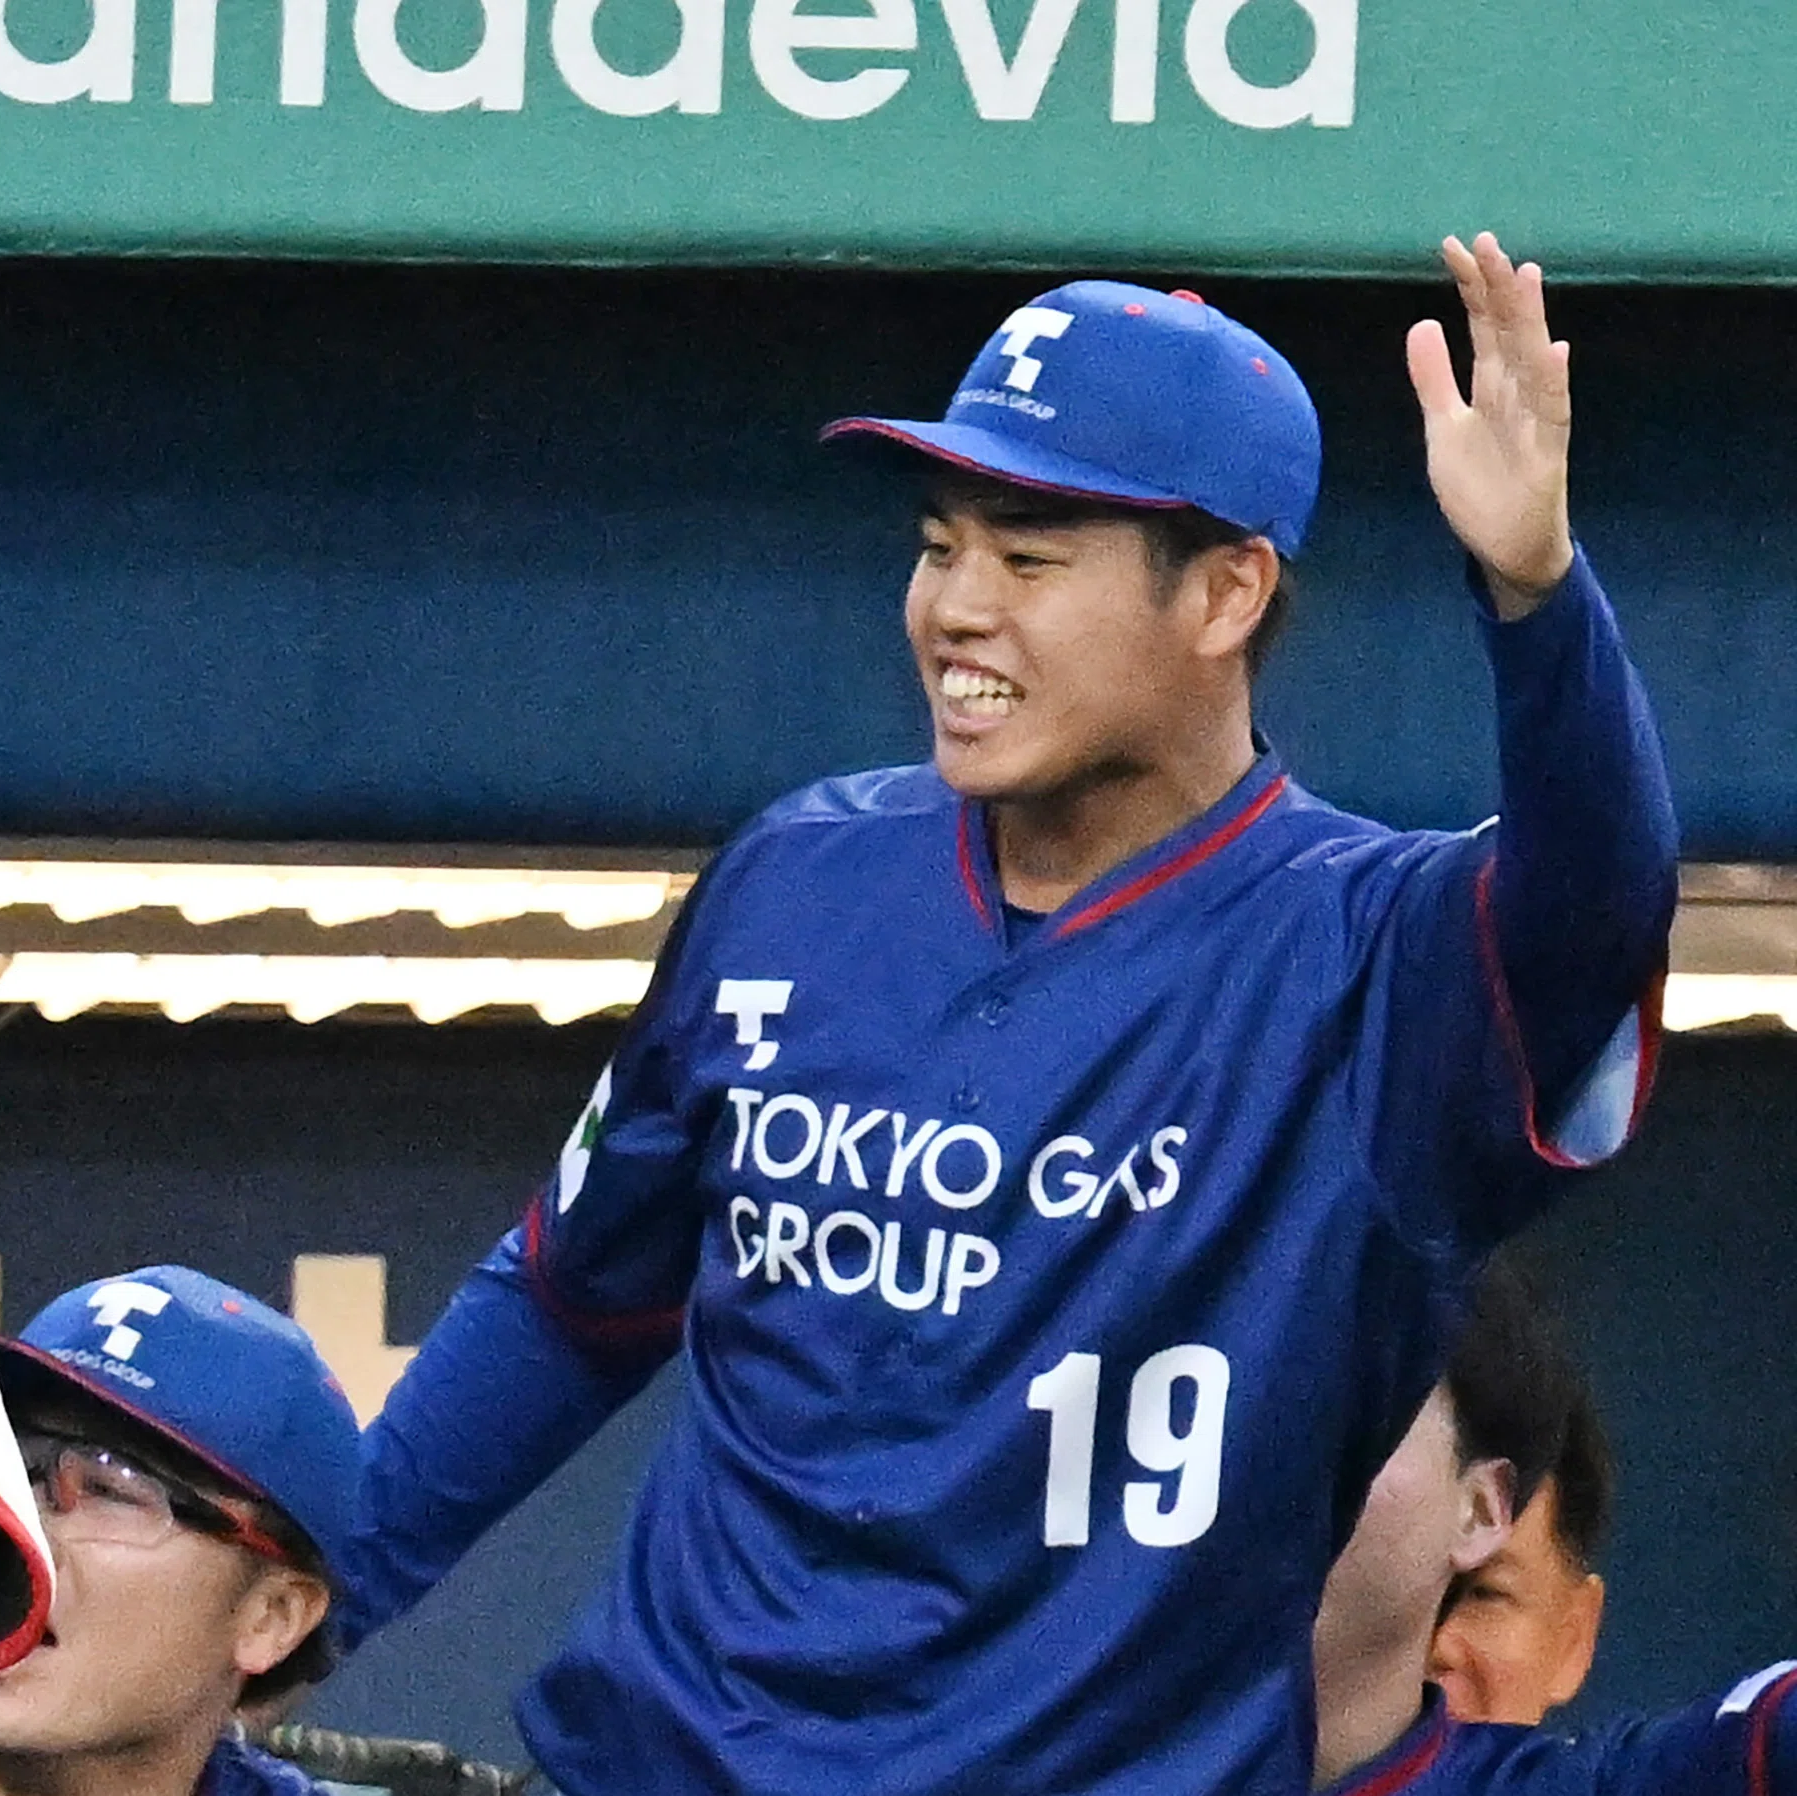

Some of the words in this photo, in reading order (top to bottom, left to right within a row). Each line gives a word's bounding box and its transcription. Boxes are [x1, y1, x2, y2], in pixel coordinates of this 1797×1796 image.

[726, 1087, 1002, 1210] TOKYO
[1028, 1125, 1188, 1219] GAS
[729, 1195, 1001, 1316] GROUP
[103, 1359, 157, 1390] GROUP
[1026, 1342, 1231, 1548] 19
